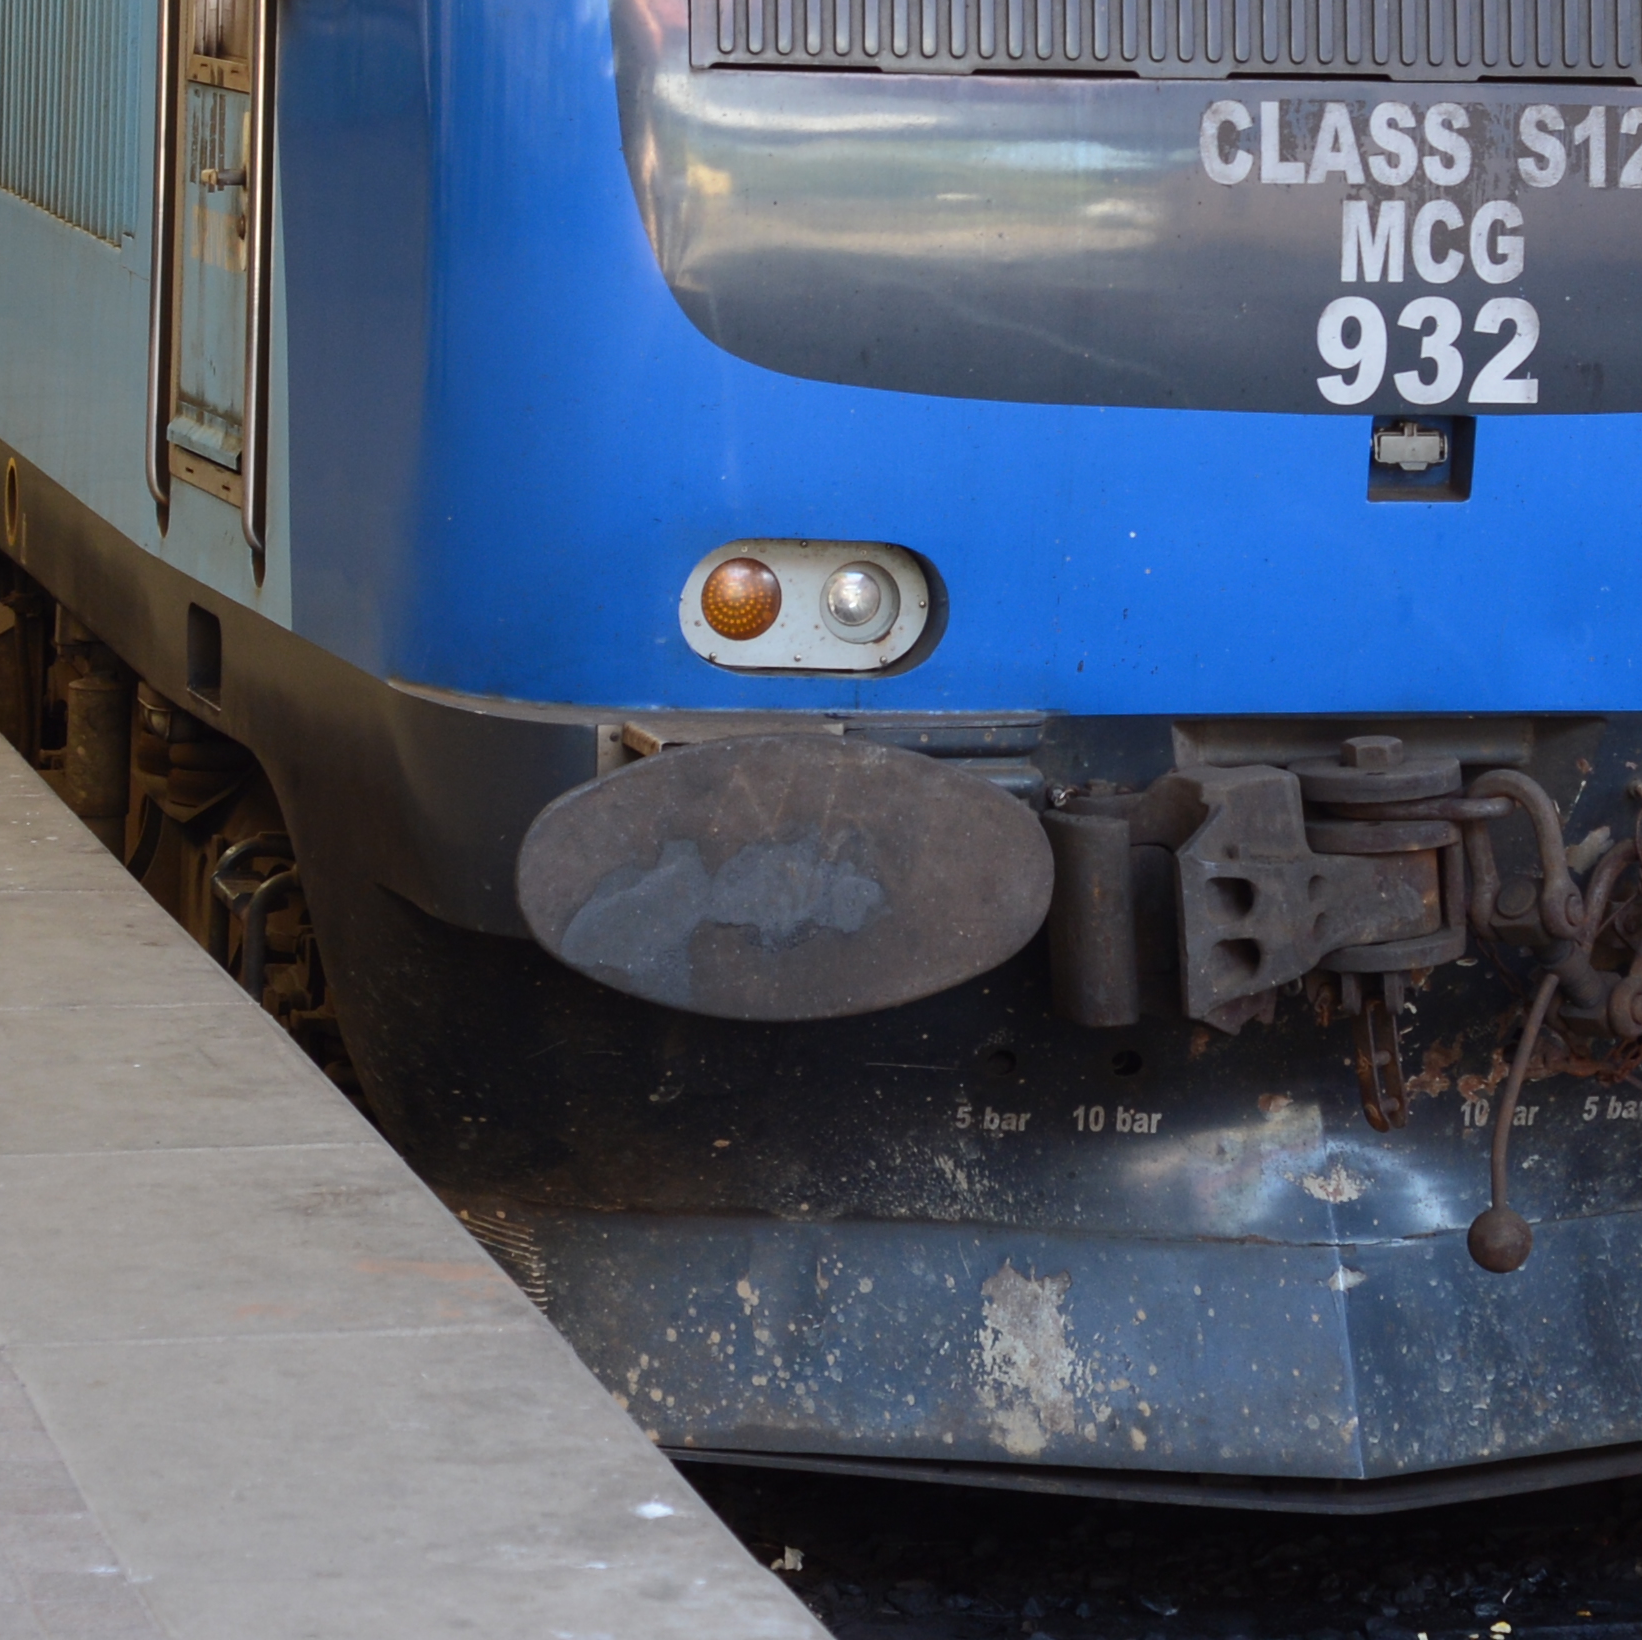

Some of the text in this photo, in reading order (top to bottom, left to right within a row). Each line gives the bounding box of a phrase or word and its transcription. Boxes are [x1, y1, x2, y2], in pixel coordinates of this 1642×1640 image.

[1199, 99, 1472, 187] CLASS
[1340, 199, 1526, 285] MCG
[1315, 295, 1541, 407] 932
[955, 1105, 1031, 1132] 5 bar
[1073, 1105, 1162, 1134] 10 bar
[1460, 1098, 1540, 1127] 10 ar
[1582, 1096, 1600, 1121] 5
